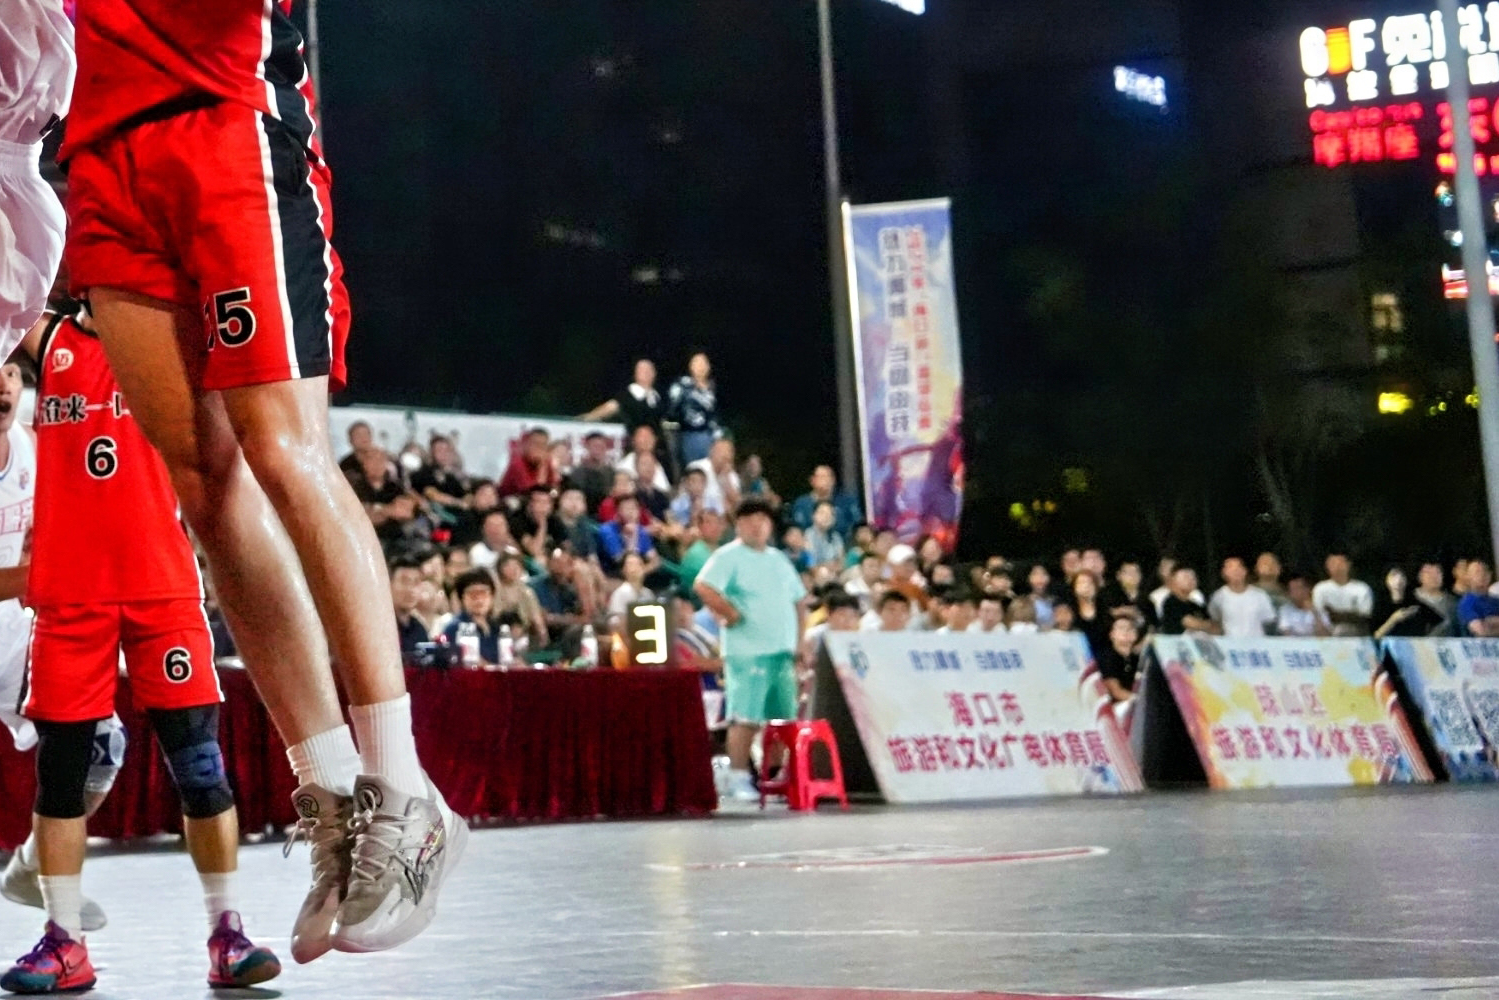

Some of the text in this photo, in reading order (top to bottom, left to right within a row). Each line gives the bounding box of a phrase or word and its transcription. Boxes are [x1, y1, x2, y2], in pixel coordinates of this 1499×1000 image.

[85, 436, 118, 480] 6
[633, 604, 668, 664] 3
[163, 647, 193, 684] 6
